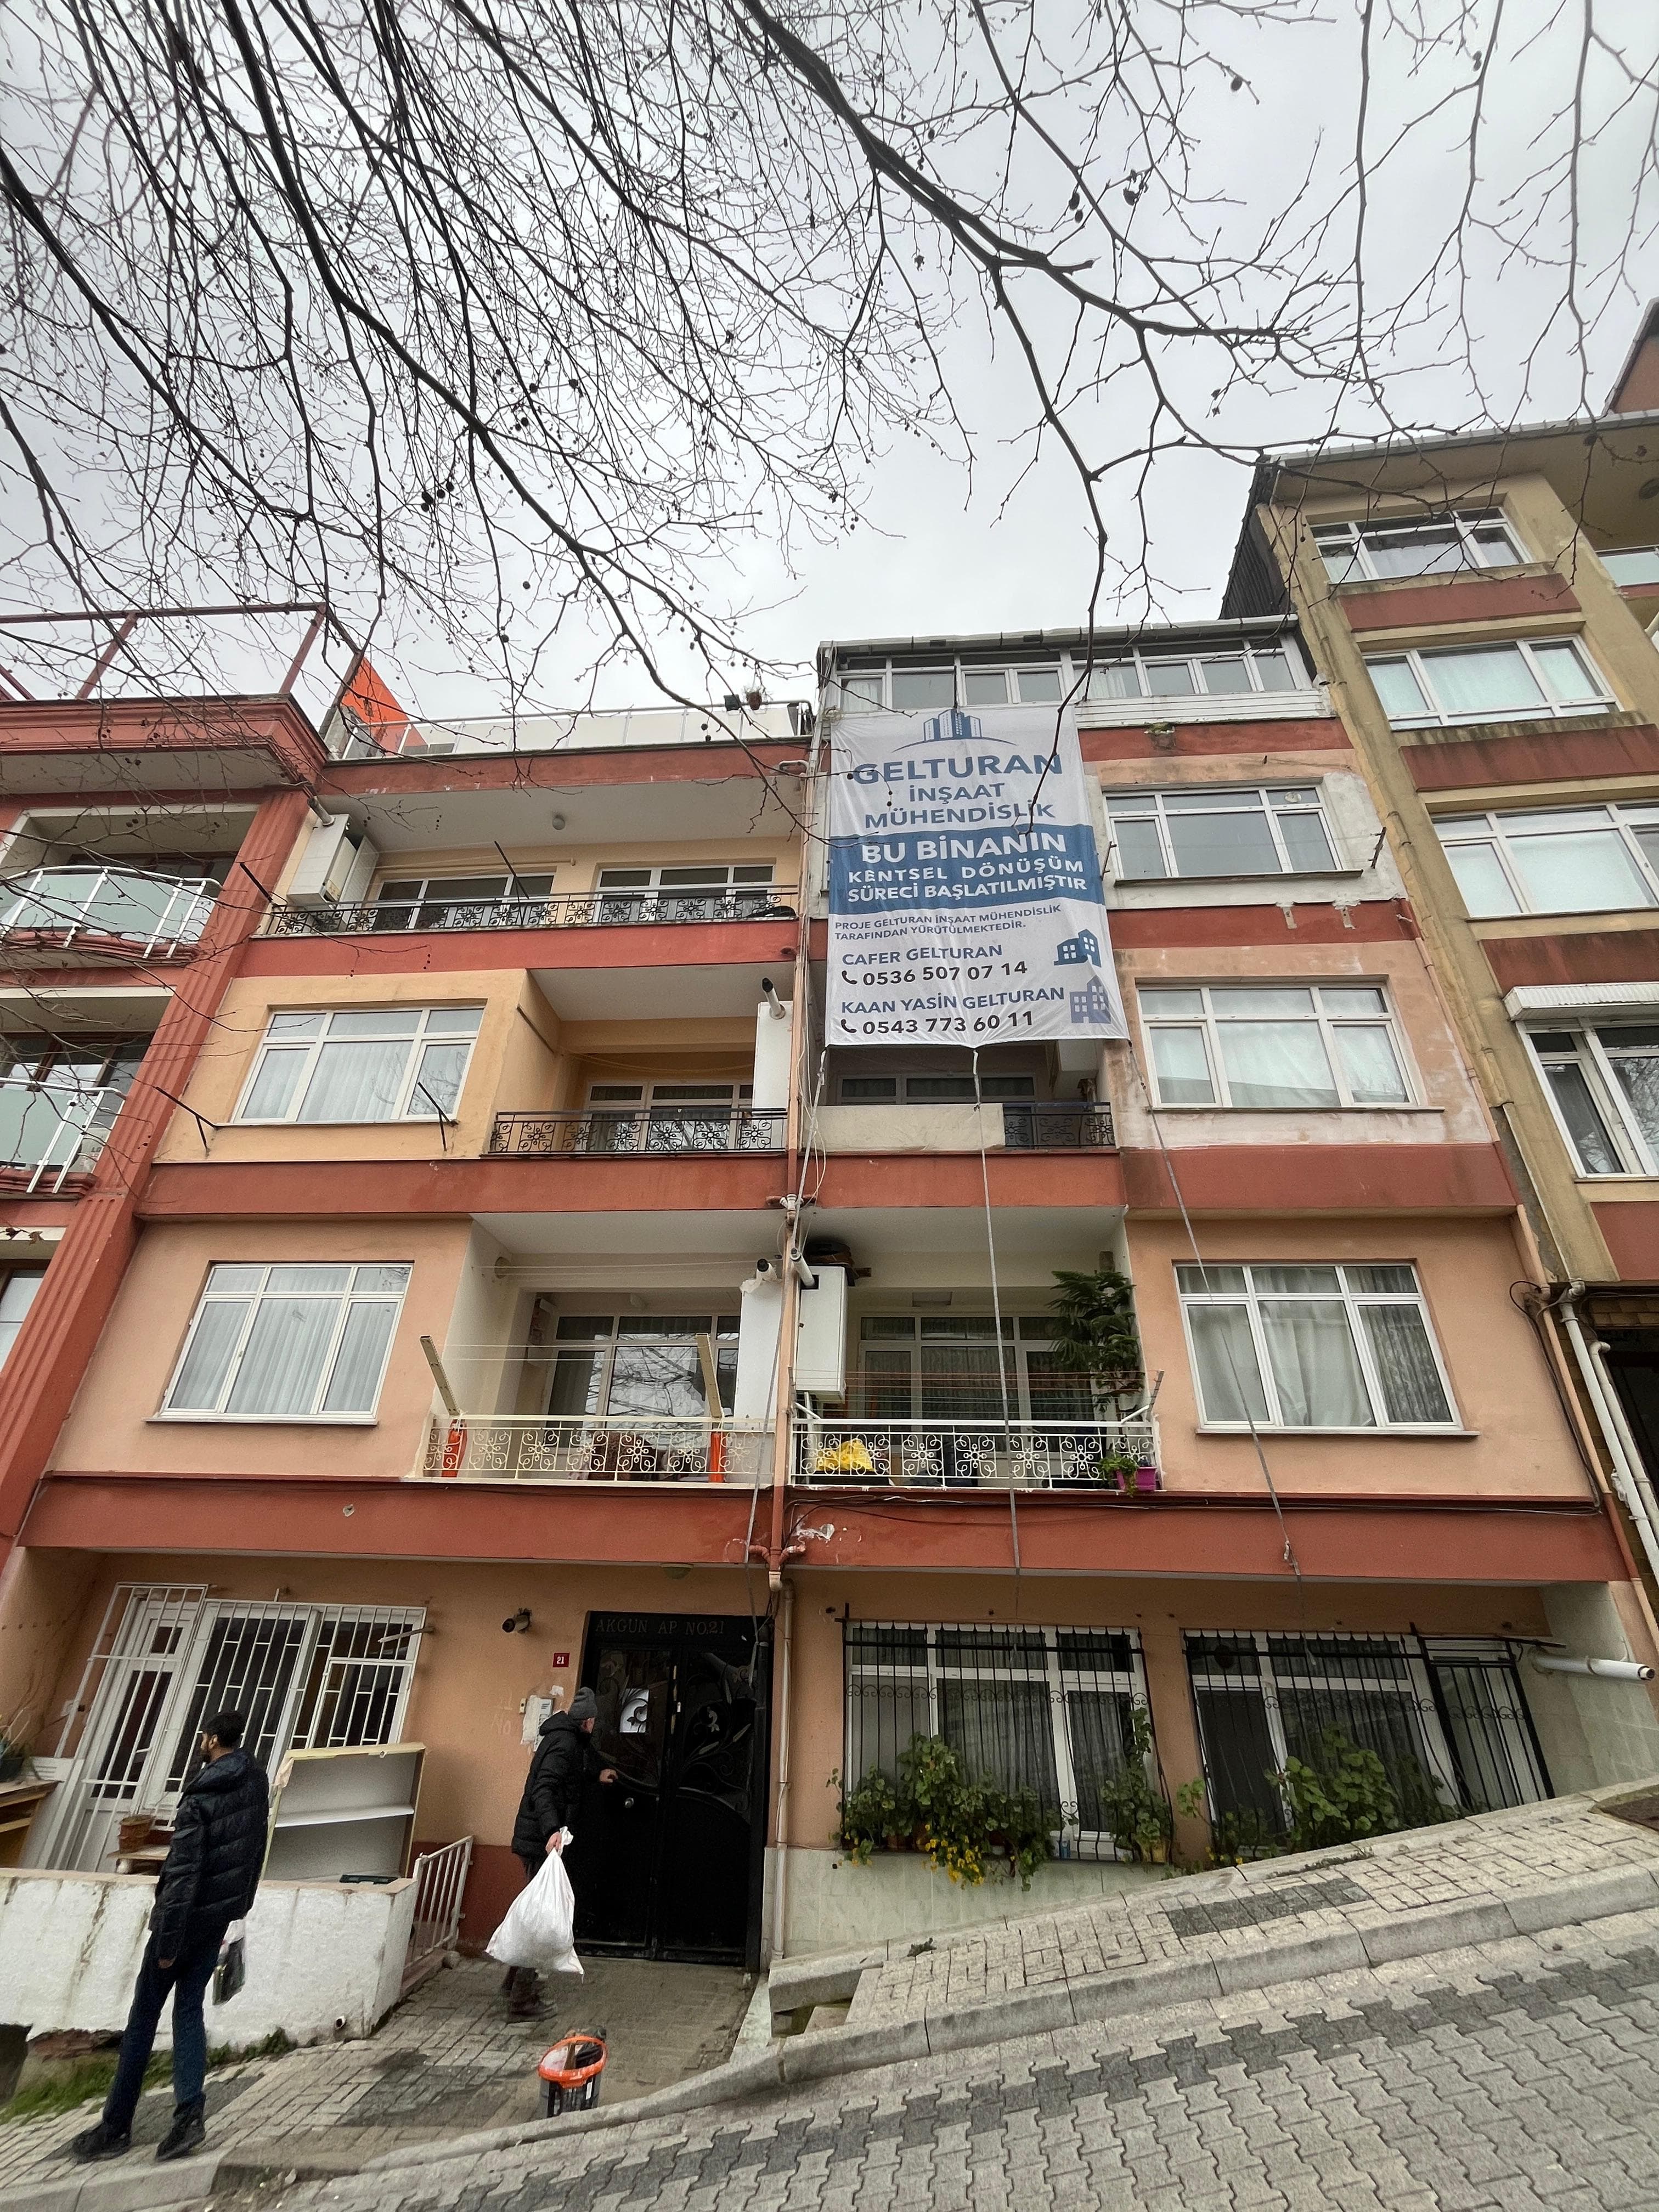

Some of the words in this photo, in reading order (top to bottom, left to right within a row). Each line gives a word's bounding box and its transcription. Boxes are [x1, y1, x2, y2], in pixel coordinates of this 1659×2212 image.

[853, 754, 1063, 785] GELTURAN
[909, 783, 1005, 804] İNŞAAT
[865, 799, 1056, 828] MÜHENDİSLİK
[862, 842, 905, 864] BU
[917, 832, 1066, 860] BİNANIN
[849, 867, 947, 883] KENTSEL
[962, 855, 1083, 878] DÖNÜŞÜM
[848, 883, 918, 902] SÜRECİ
[925, 874, 1087, 900] BAŞLATILMIŞTIR
[835, 921, 871, 929] PROJE
[874, 916, 932, 928] GELTURAN
[935, 915, 976, 925] İNŞAAT
[979, 905, 1061, 922] MÜHENDİSLİK
[834, 927, 907, 940] TARAFINDAN
[911, 920, 1026, 935] YÜRÜTÜLMEKTEDİR.
[842, 951, 900, 966] CAFER
[906, 945, 1002, 960] GELTURAN
[863, 969, 916, 986] 0536
[922, 966, 960, 981] 507
[967, 964, 994, 980] 07
[1001, 961, 1028, 976] 14
[842, 1000, 895, 1013] KAAN
[900, 992, 957, 1011] YASİN
[962, 988, 1064, 1009] GELTURAN
[863, 1019, 918, 1035] 0543
[926, 1017, 966, 1032] 773
[973, 1015, 1000, 1032] 60
[1007, 1011, 1032, 1026] 11
[657, 1621, 678, 1634] AP
[556, 1656, 565, 1664] 21
